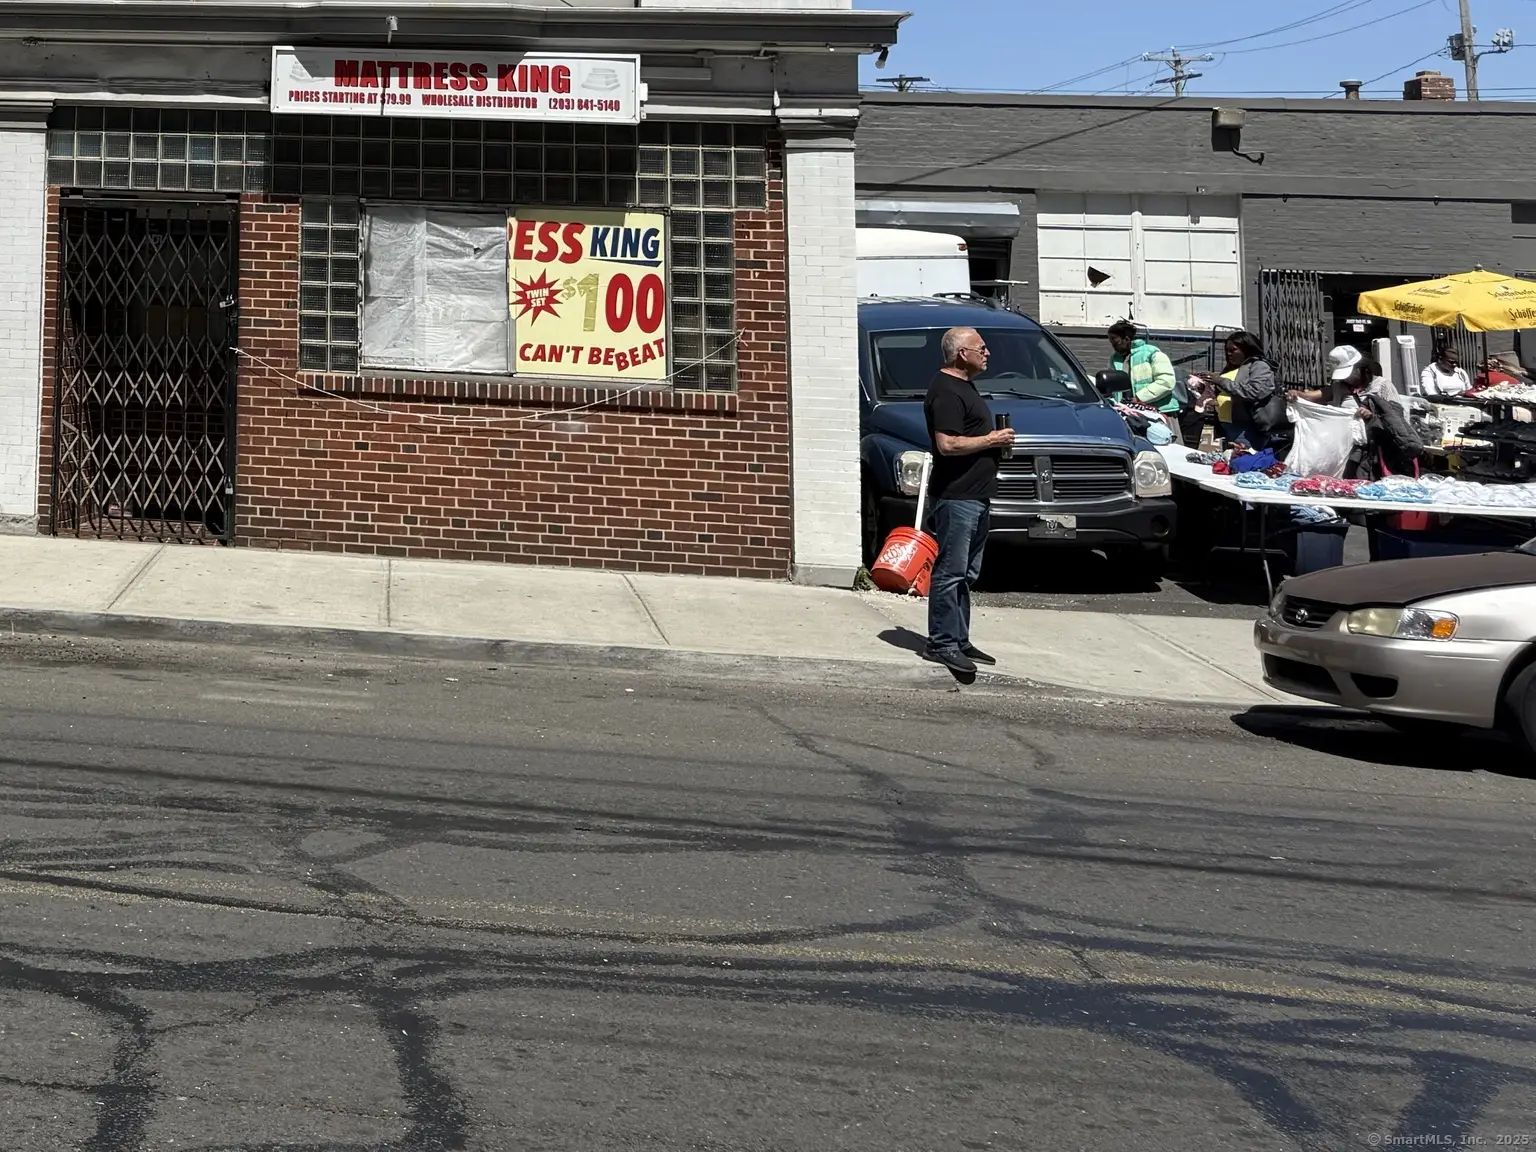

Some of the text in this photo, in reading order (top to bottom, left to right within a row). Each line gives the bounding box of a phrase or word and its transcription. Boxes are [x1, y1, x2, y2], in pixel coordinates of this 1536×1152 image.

[334, 59, 571, 94] MATTRESS KING
[288, 90, 621, 112] PRICES STARTING AT $79.99 WHOLESALE DISTRIBUTOR (203) 841-5140
[508, 219, 661, 264] ESS KING
[525, 288, 550, 299] TWIN
[530, 297, 547, 308] SET
[519, 338, 665, 372] CAN'T BE BEAT
